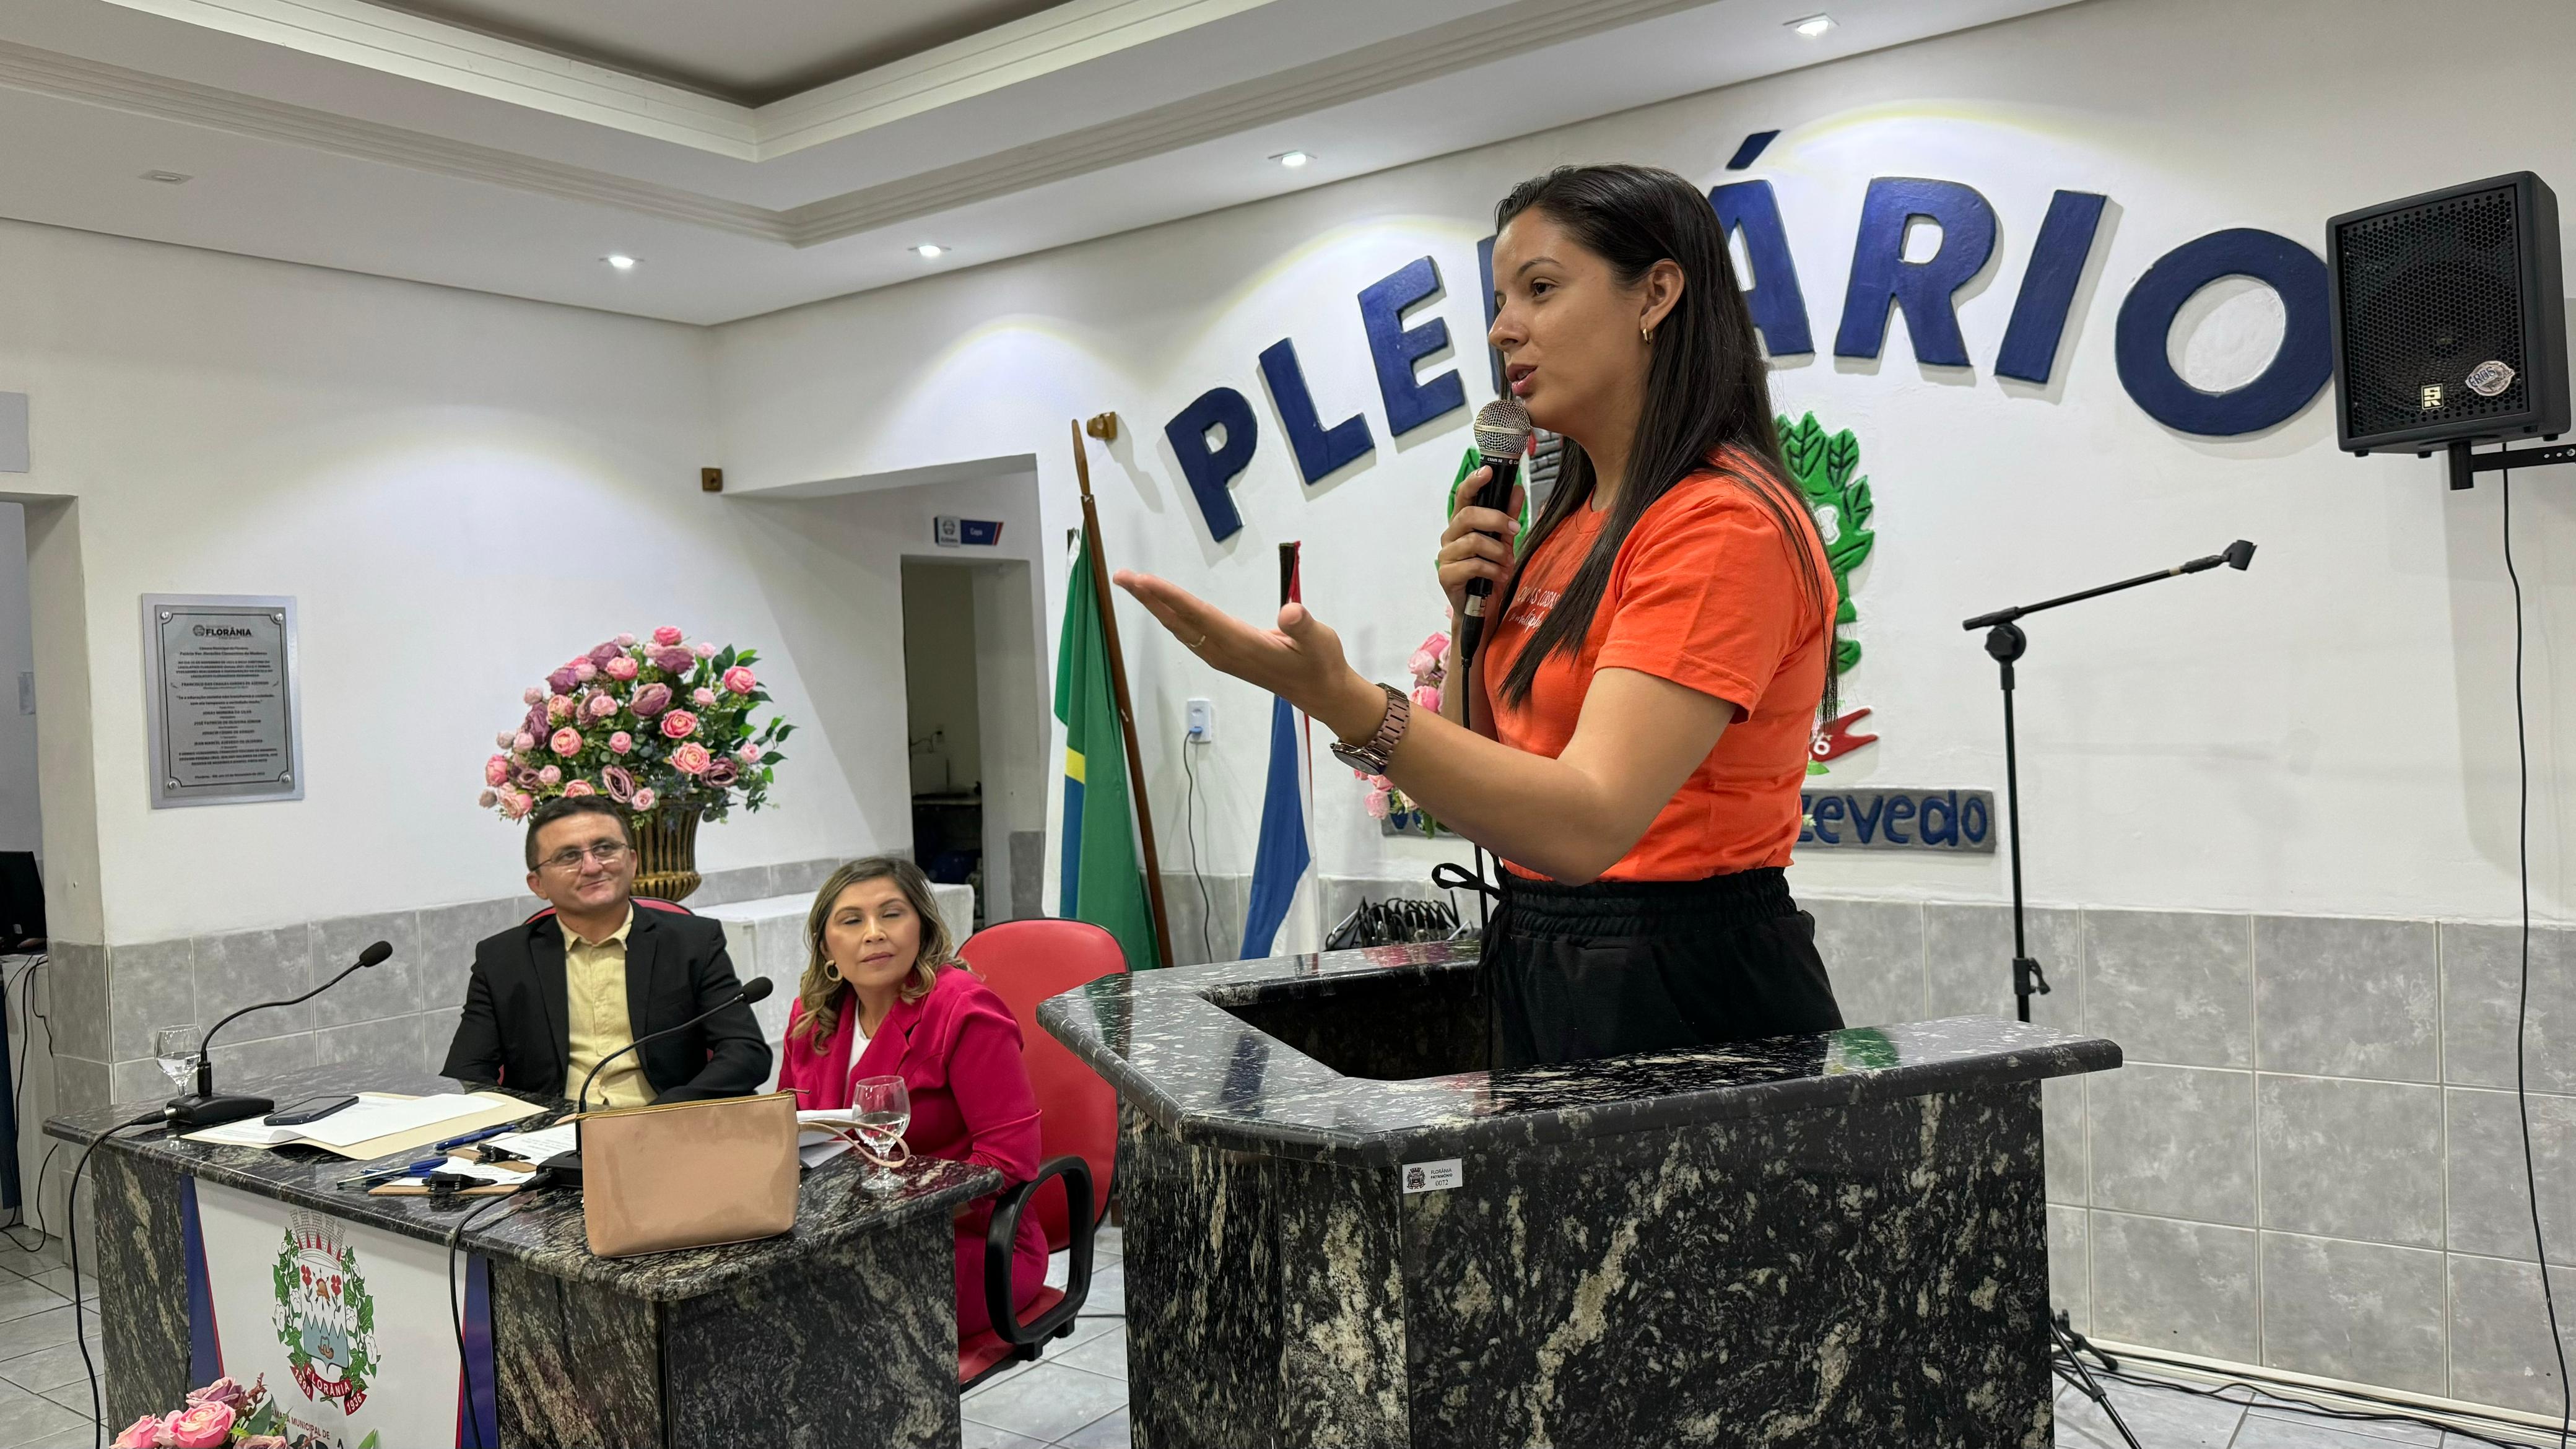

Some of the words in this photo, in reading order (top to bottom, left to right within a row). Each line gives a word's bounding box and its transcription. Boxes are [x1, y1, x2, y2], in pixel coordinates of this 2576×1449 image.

[1164, 129, 2333, 539] PLEÁRIO
[1796, 789, 1988, 846] zevedo
[294, 1369, 310, 1396] 1890
[306, 1367, 350, 1396] FLORÂNIA
[346, 1393, 362, 1412] 1936
[292, 1416, 321, 1437] MUNICIPAL
[323, 1429, 330, 1440] DE
